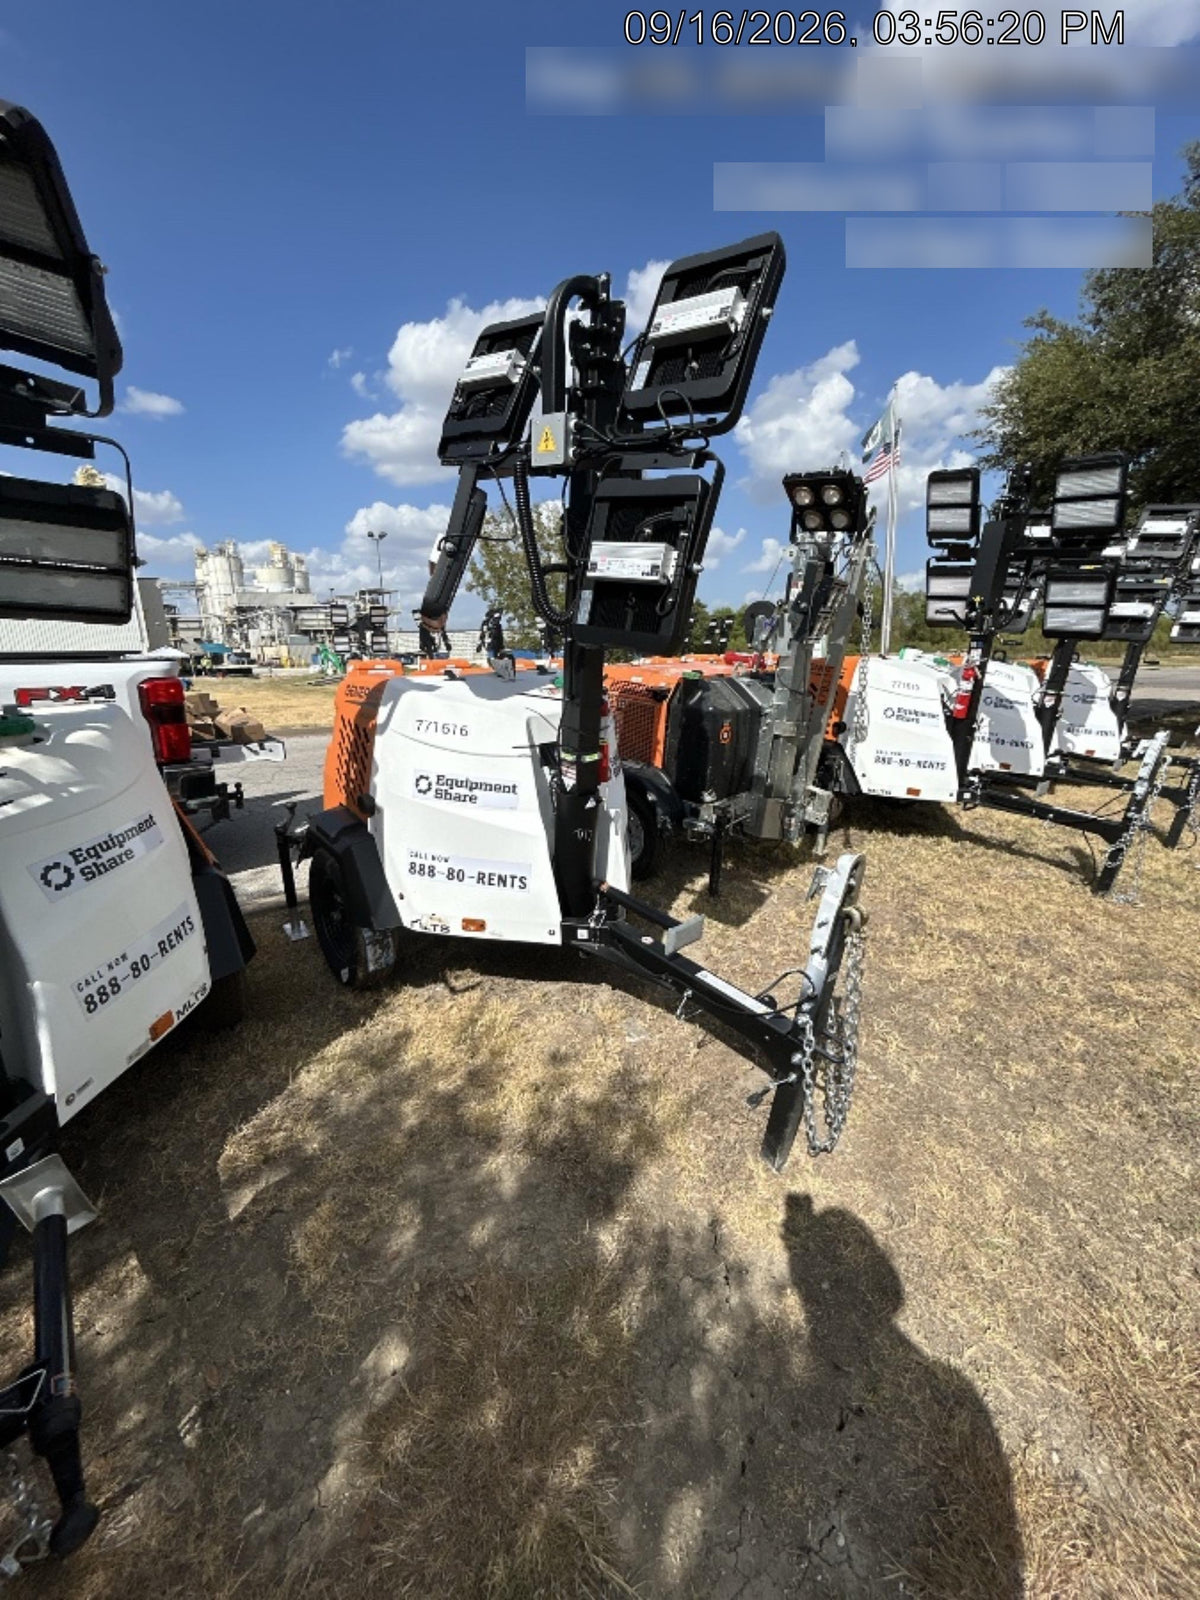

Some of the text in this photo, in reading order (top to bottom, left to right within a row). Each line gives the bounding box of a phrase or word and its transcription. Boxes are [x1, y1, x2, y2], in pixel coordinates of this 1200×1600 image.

[13, 684, 116, 707] FX4
[434, 787, 478, 804] Share
[435, 774, 518, 795] Equipment
[69, 813, 157, 866] Equipment
[79, 847, 135, 882] Share
[408, 861, 528, 890] 888-80-RENTS
[77, 952, 129, 993] CALL NOW
[84, 915, 195, 1015] 888-80-RENTS
